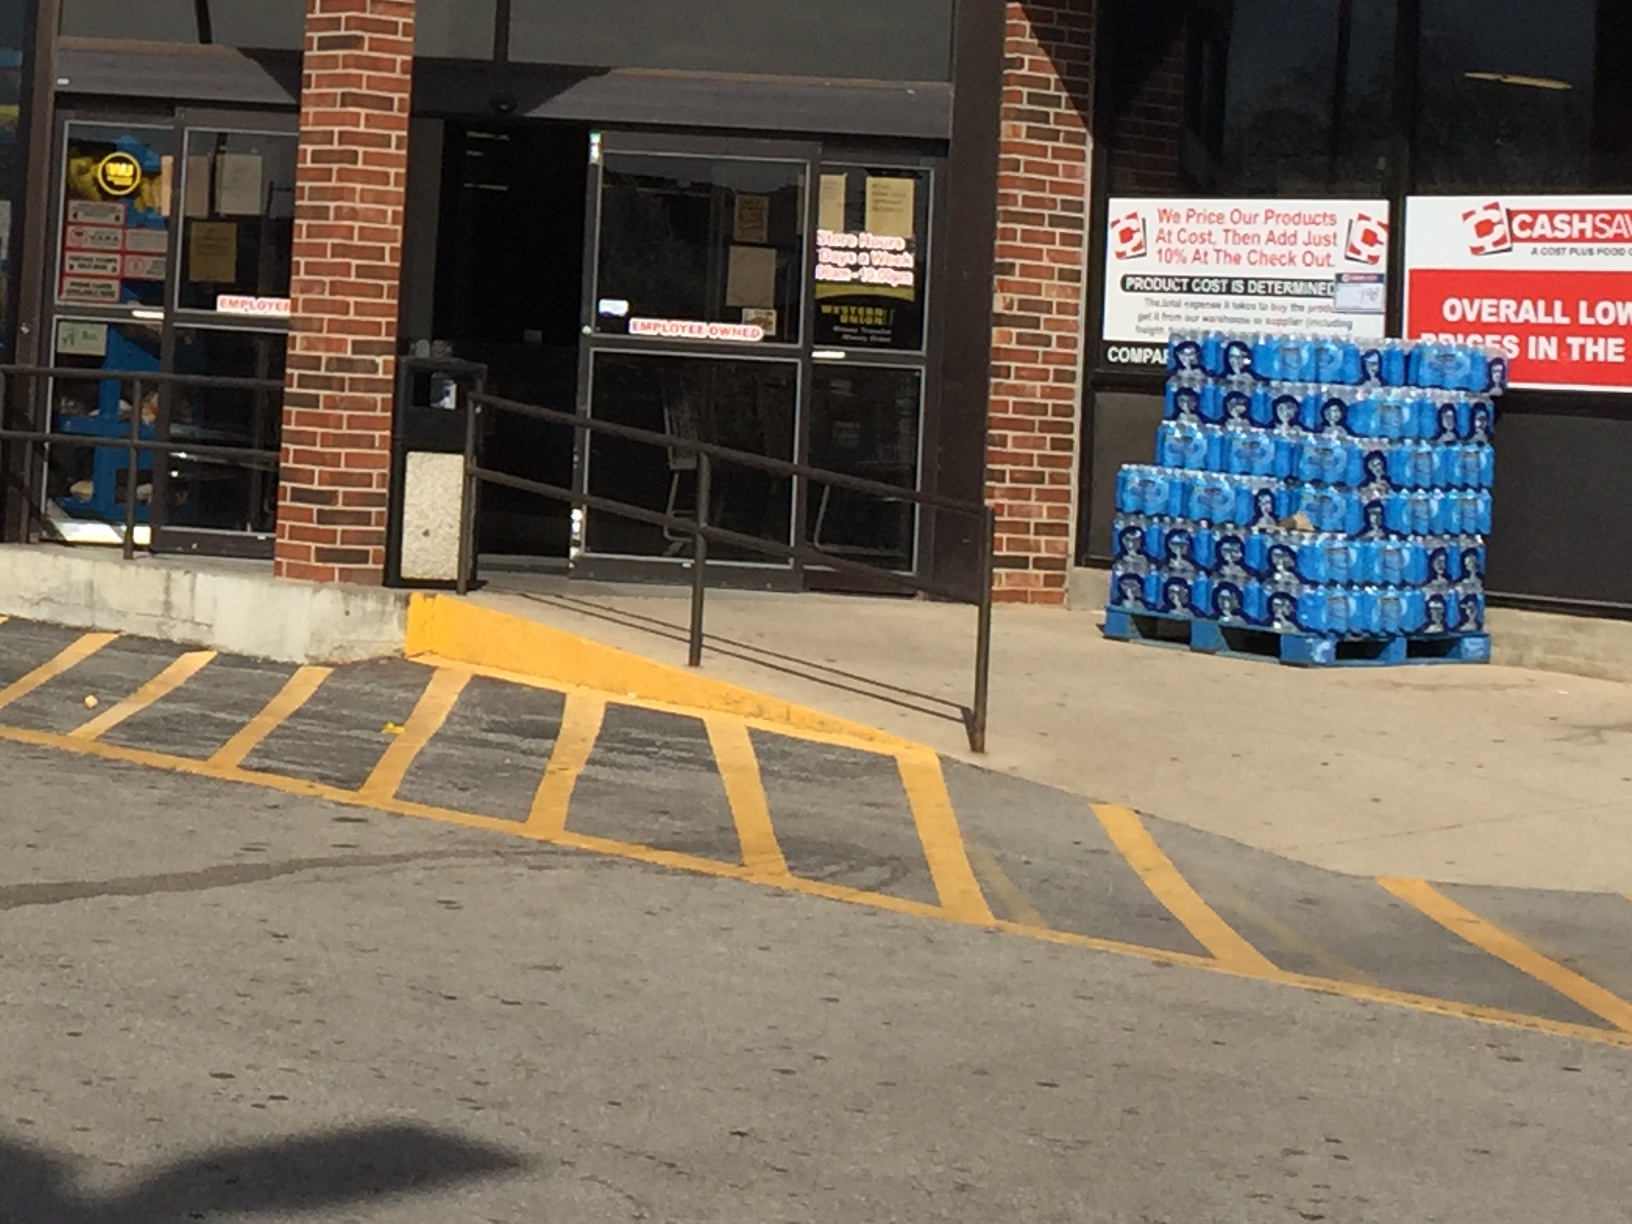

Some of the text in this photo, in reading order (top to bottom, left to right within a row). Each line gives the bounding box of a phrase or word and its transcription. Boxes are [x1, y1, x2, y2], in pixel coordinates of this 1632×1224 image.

[1156, 208, 1338, 227] We Price Our Products
[816, 230, 906, 251] Store Hours
[1156, 228, 1172, 244] At
[1223, 229, 1261, 245] Then
[1265, 230, 1299, 246] Add
[1303, 230, 1338, 247] Just
[870, 251, 915, 267] Week
[1156, 248, 1188, 265] 10%
[1190, 248, 1209, 265] At
[1213, 248, 1241, 266] The
[1247, 248, 1297, 267] Check
[1541, 247, 1567, 256] COST
[1569, 247, 1594, 256] PLUS
[1597, 248, 1626, 257] FOOD
[1125, 277, 1190, 292] PRODUCT
[1191, 278, 1229, 293] COST
[1231, 279, 1244, 293] IS
[1271, 302, 1287, 313] buy
[1307, 304, 1335, 314] produ
[1442, 297, 1571, 324] OVERALL
[631, 320, 761, 339] EMPLOYEE OWNED
[1527, 335, 1558, 360] IN
[1566, 337, 1626, 362] THE
